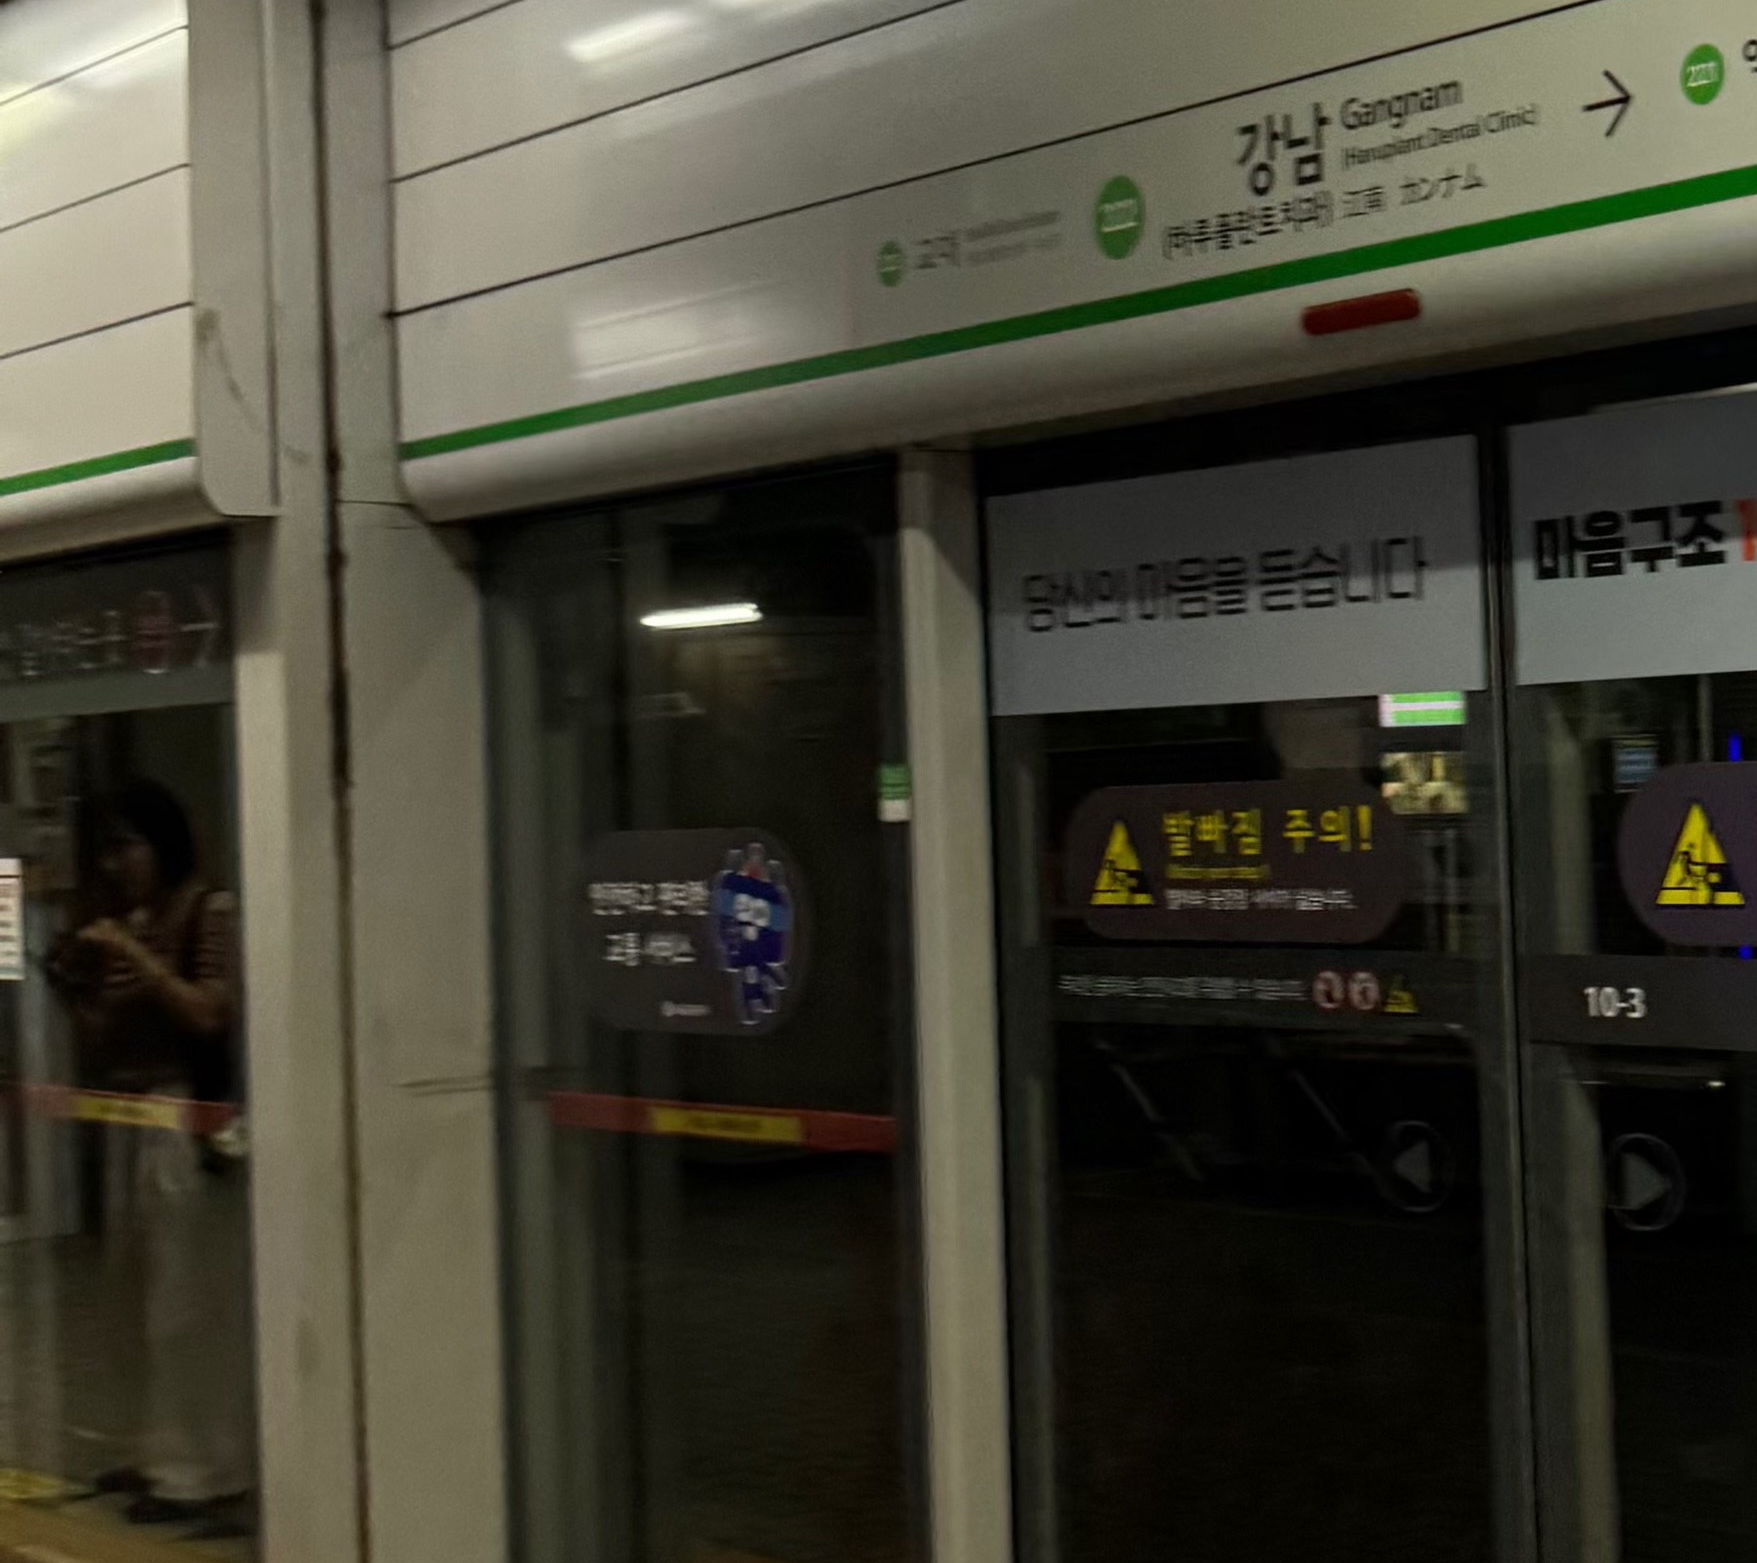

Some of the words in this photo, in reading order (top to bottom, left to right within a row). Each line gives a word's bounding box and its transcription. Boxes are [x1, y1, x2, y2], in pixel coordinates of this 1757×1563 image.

[1340, 80, 1463, 131] Gangnam
[1236, 102, 1331, 196] 강남
[1137, 555, 1247, 621] 마음을
[1258, 535, 1429, 612] 듣습니다
[1282, 804, 1374, 853] 주의!
[1583, 985, 1648, 1020] 10-3
